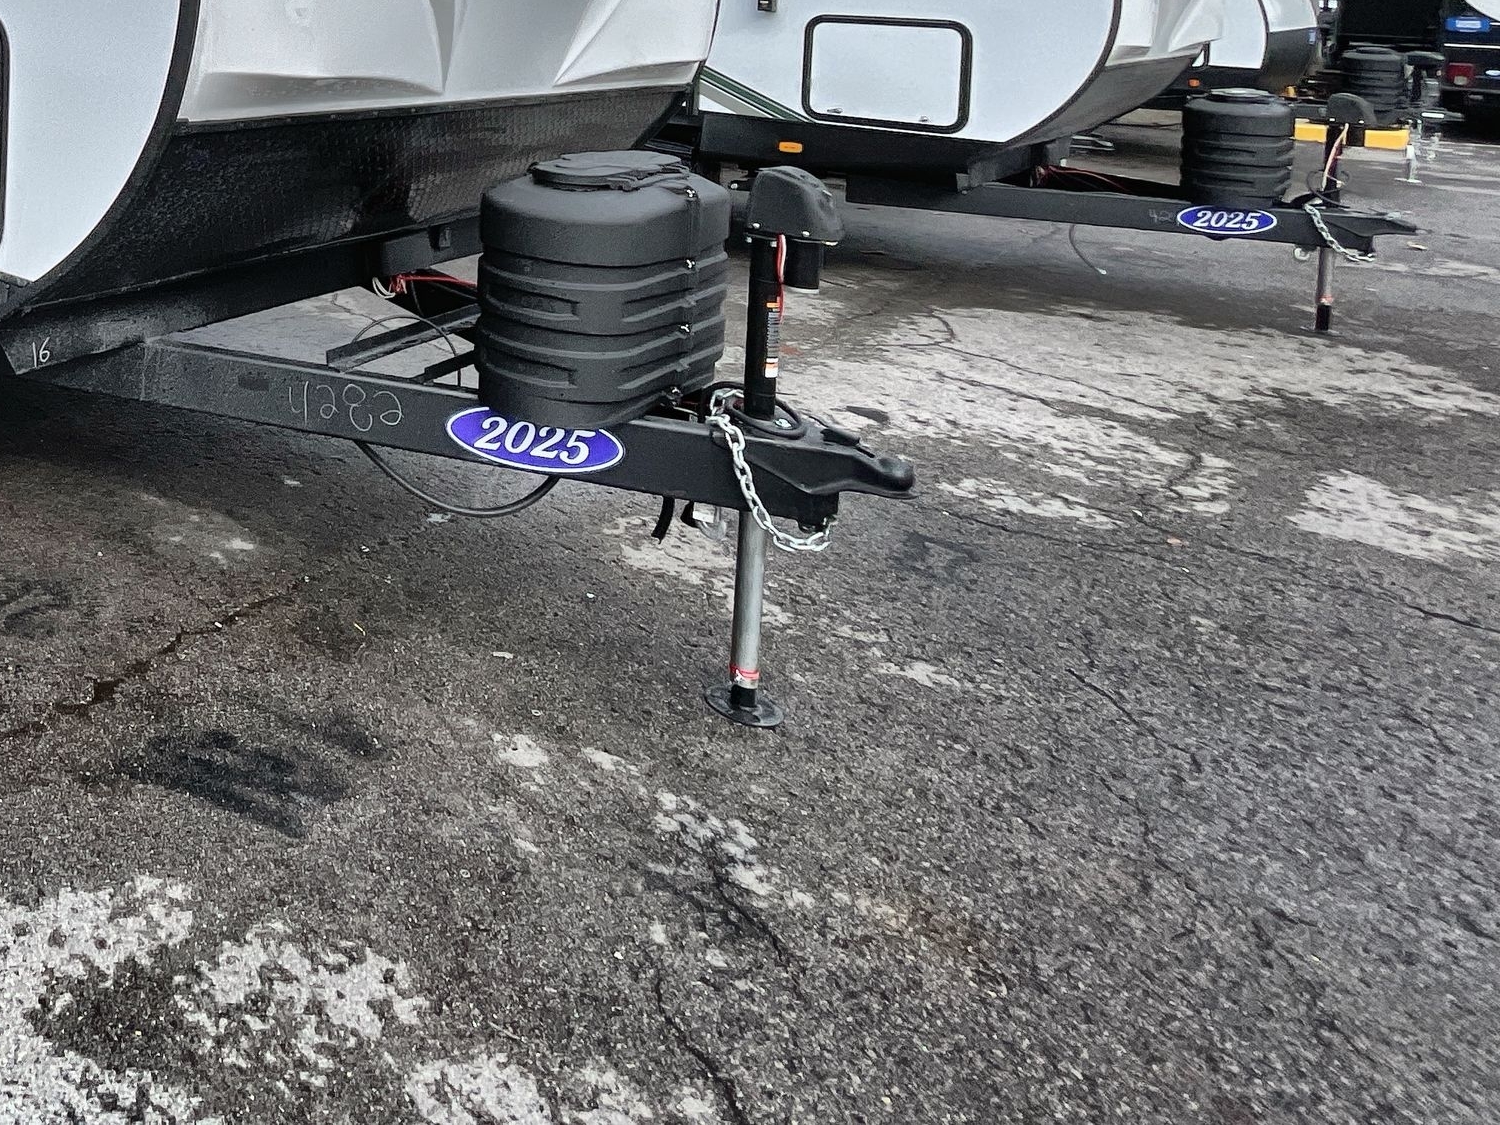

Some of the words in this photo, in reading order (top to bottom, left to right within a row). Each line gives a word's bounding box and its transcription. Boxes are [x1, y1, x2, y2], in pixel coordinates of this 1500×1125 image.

[1192, 210, 1262, 230] 2025
[32, 336, 50, 368] 16
[288, 381, 405, 432] 4282
[473, 416, 597, 466] 2025
